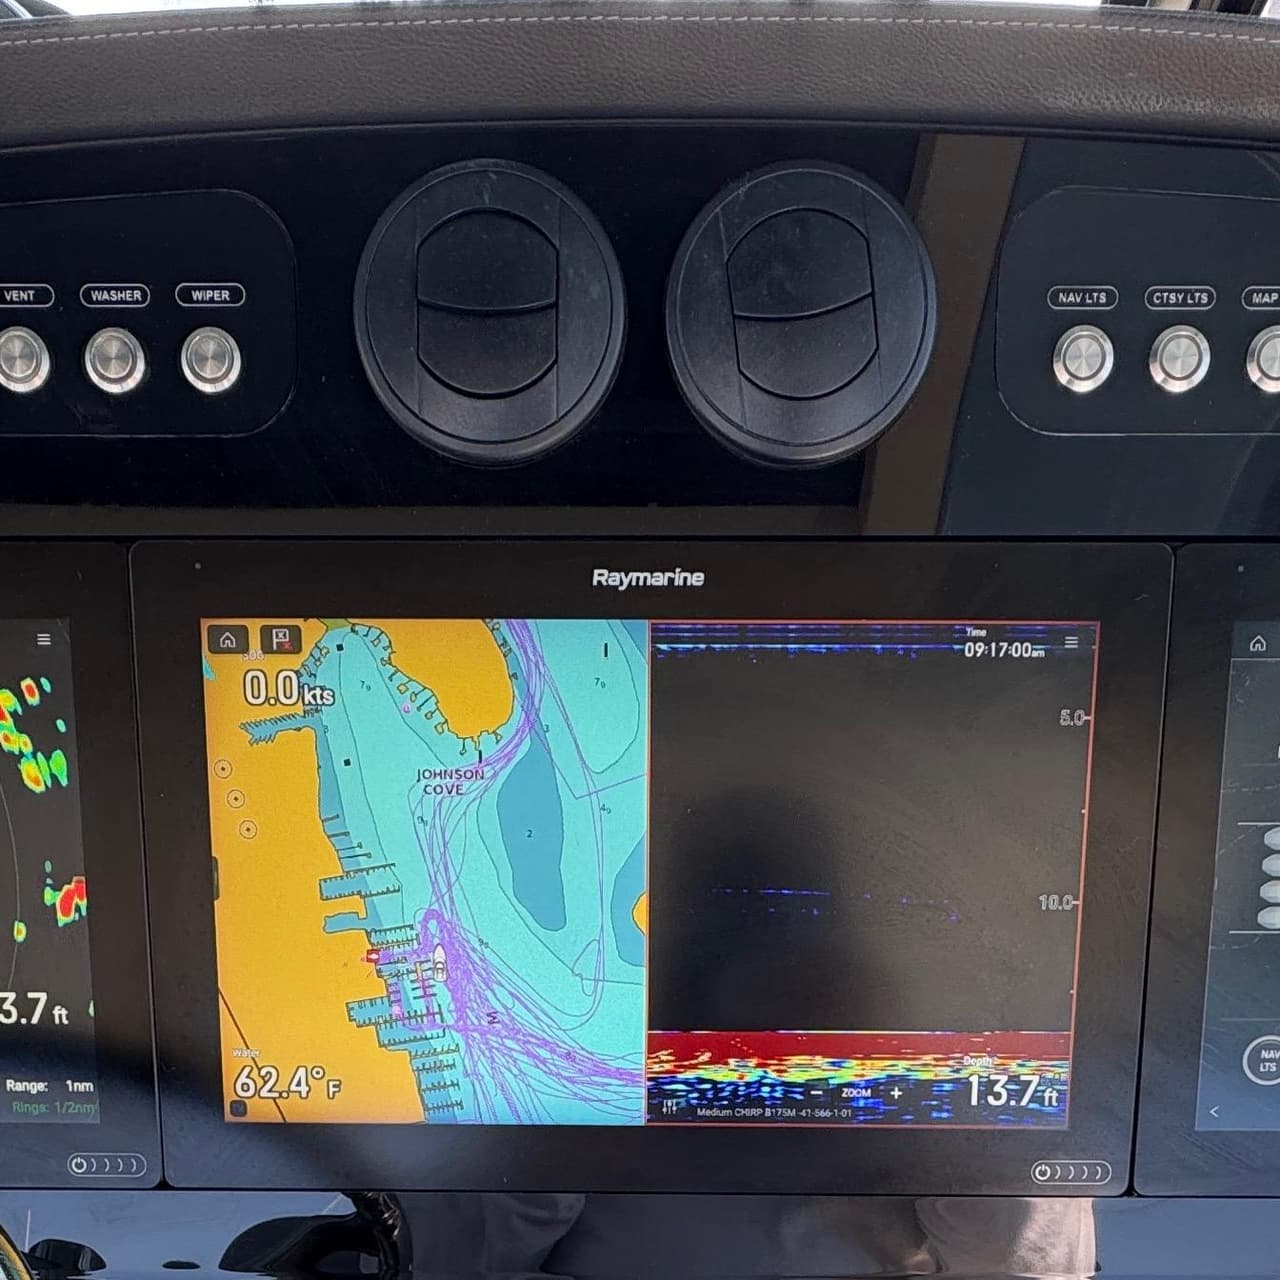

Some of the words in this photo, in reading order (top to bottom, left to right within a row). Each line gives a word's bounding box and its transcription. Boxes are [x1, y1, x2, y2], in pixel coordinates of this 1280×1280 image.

[3, 289, 35, 302] VENT
[90, 289, 142, 302] WASHER
[191, 289, 231, 301] WIPER
[1058, 292, 1082, 303] NAV
[1085, 292, 1107, 303] LTS
[1153, 292, 1184, 304] CTSY
[1186, 292, 1209, 304] LTS
[1252, 292, 1279, 304] MAP
[592, 567, 705, 591] Raymarine
[966, 627, 987, 637] Time
[243, 668, 299, 706] 0.0
[303, 684, 335, 706] kts
[1060, 709, 1085, 726] 5.0
[417, 769, 485, 783] JOHNSON
[423, 783, 464, 796] COVE
[1039, 895, 1073, 910] 10.0
[52, 1005, 69, 1025] ft
[963, 1055, 993, 1068] Depth
[1259, 1063, 1277, 1073] LTS
[6, 1079, 49, 1094] Range:
[66, 1080, 94, 1092] 1nm
[327, 1079, 341, 1099] F
[841, 1087, 871, 1098] ZOOM
[968, 1073, 1040, 1107] 13.7
[1043, 1088, 1058, 1107] ft
[13, 1102, 49, 1115] Rings:
[697, 1108, 732, 1117] Medium
[734, 1108, 763, 1117] CHIRP
